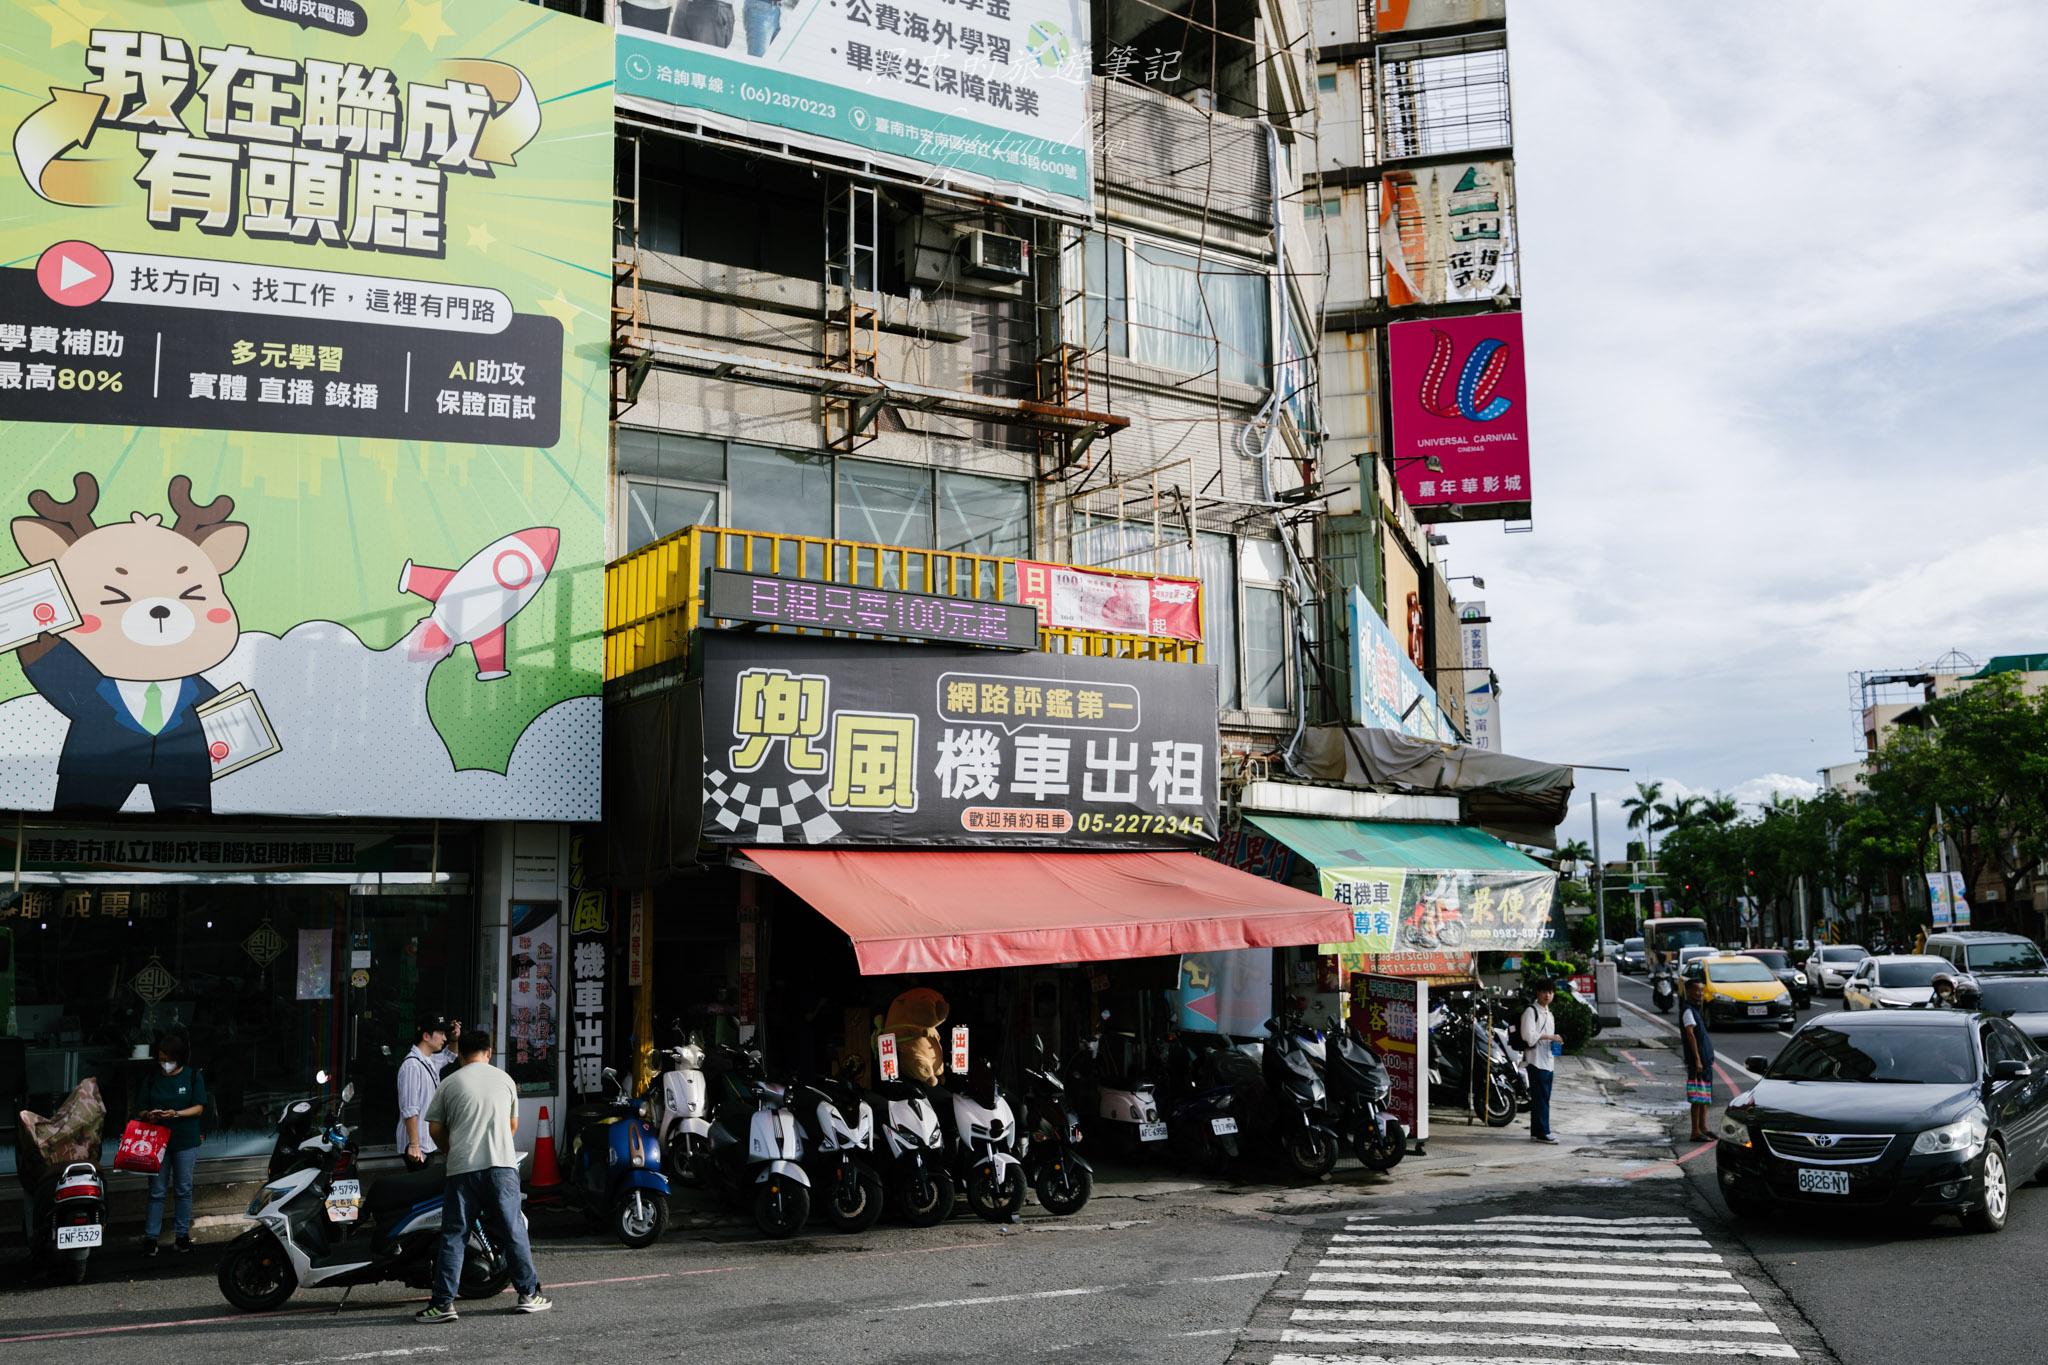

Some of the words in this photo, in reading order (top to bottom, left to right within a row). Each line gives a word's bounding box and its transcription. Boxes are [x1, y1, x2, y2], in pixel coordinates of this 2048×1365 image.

[846, 1, 1011, 65] 公費海外學習
[846, 40, 1040, 117] 畢業生保障就業
[86, 29, 492, 174] 我在聯成
[135, 132, 446, 258] 有頭鹿
[231, 339, 343, 373] 多元學習
[449, 360, 525, 386] AI助攻
[188, 371, 248, 401] 實體
[258, 375, 314, 406] 直播
[325, 381, 378, 410] 錄播
[436, 390, 536, 419] 保證面試
[1417, 436, 1468, 447] UNIVERSAL
[1473, 433, 1518, 443] CARNIVAL
[1419, 475, 1522, 497] 嘉年華影城
[750, 577, 1009, 641] 日租只要100元起
[946, 680, 1134, 721] 網路評鑑第一
[731, 668, 919, 812] 兜風
[934, 729, 1203, 806] 機車出租
[969, 810, 1066, 831] 歡迎預約租車
[1078, 813, 1204, 835] 05-2272345
[26, 839, 356, 864] 嘉義市私立聯成電腦短期補習班
[19, 889, 168, 918] 聯成電腦
[1334, 881, 1390, 905] 租機車
[1354, 911, 1391, 935] 尊客
[573, 942, 605, 1094] 機車出租
[881, 1037, 897, 1077] 出租
[953, 1029, 967, 1072] 出租
[1799, 1173, 1848, 1192] 8826-NY
[59, 1230, 100, 1244] ENF-5329
